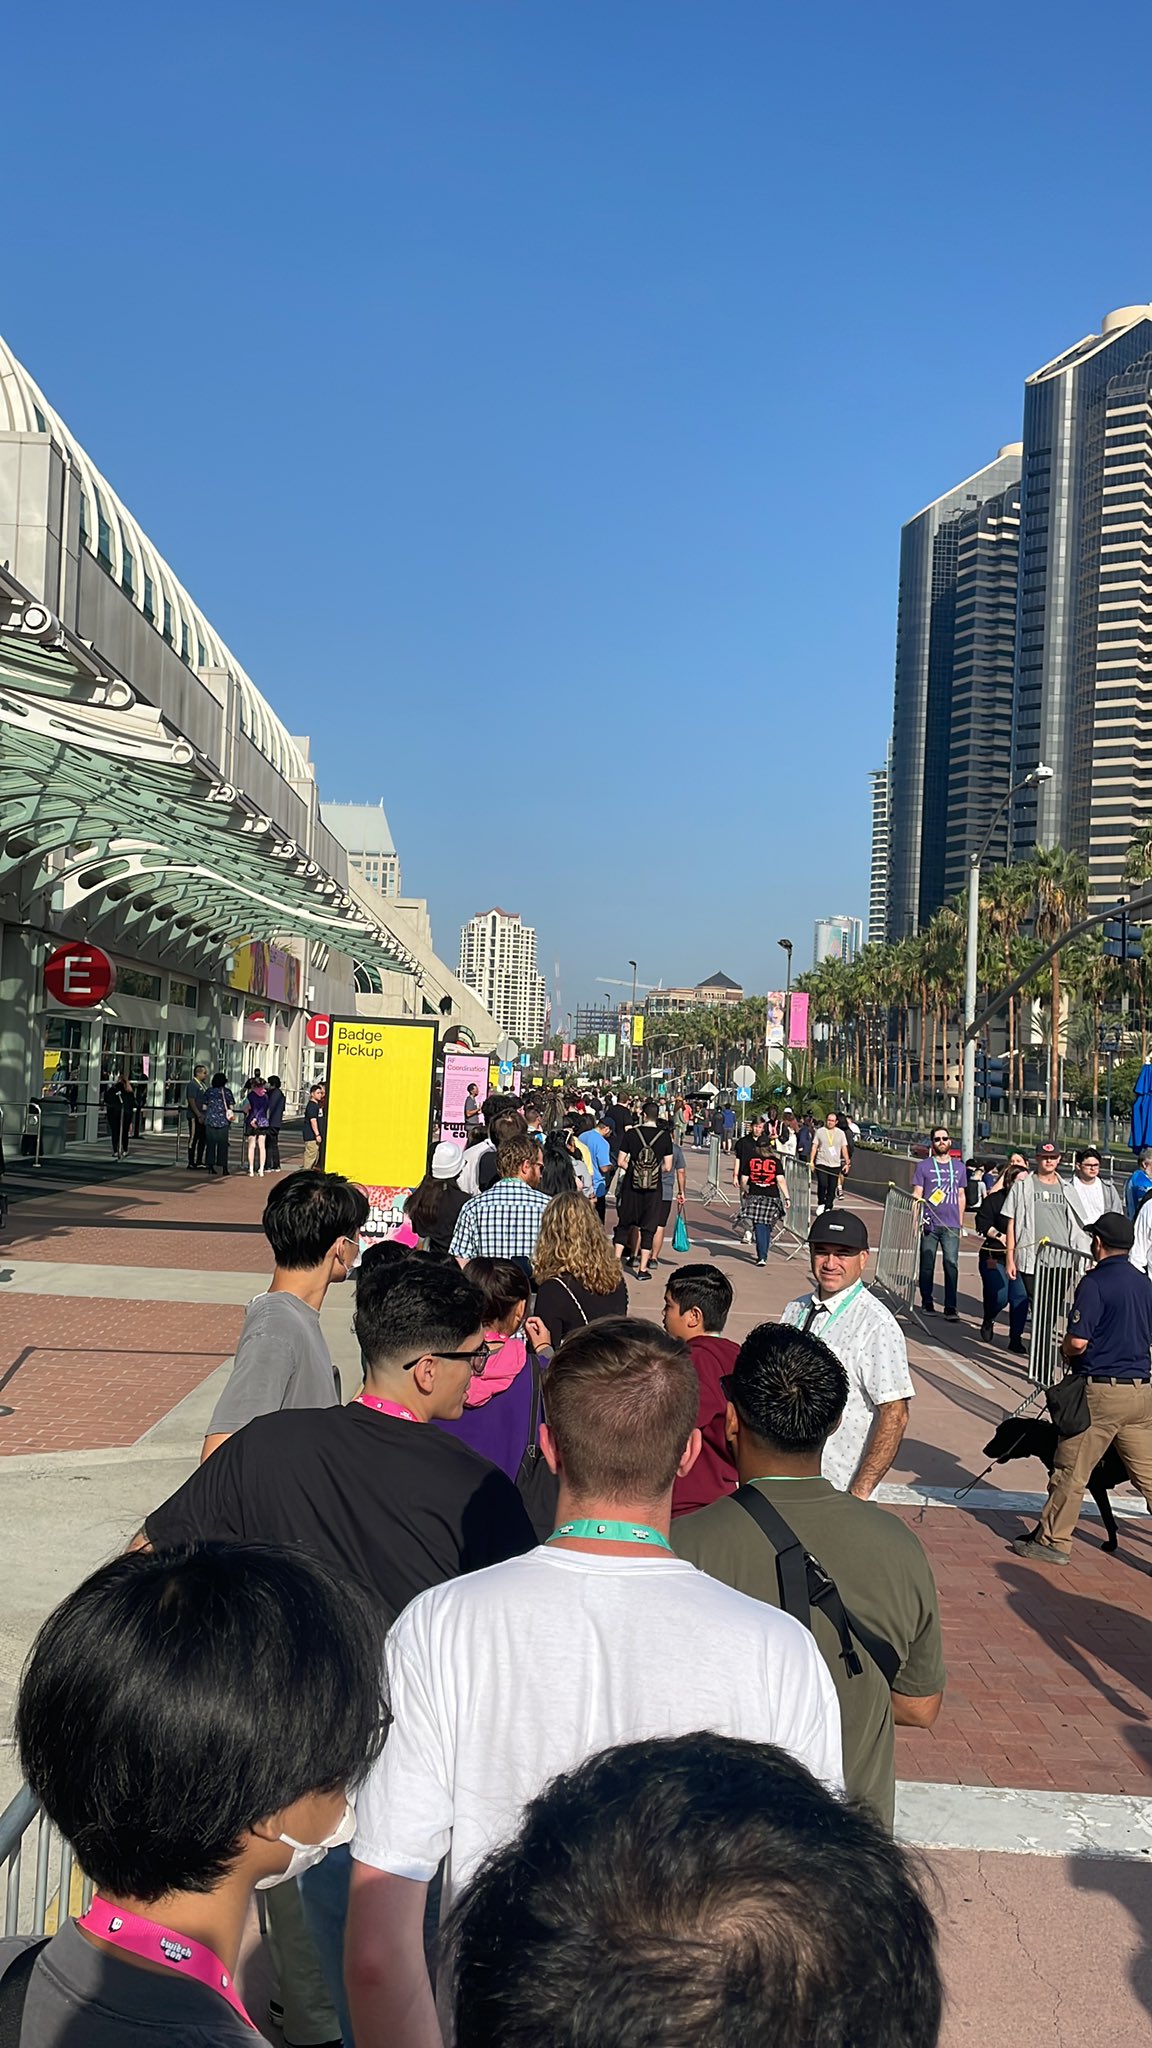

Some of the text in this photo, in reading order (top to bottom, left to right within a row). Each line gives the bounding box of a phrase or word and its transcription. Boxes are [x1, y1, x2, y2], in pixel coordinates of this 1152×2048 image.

[64, 956, 92, 994] E
[315, 1021, 330, 1039] D
[338, 1027, 383, 1044] Badge
[337, 1043, 384, 1060] Pickup
[446, 1064, 487, 1073] Coordination
[750, 1158, 776, 1173] GG
[368, 1206, 403, 1222] itch
[360, 1221, 388, 1233] on
[160, 1937, 192, 1958] twitch
[165, 1948, 182, 1961] con
